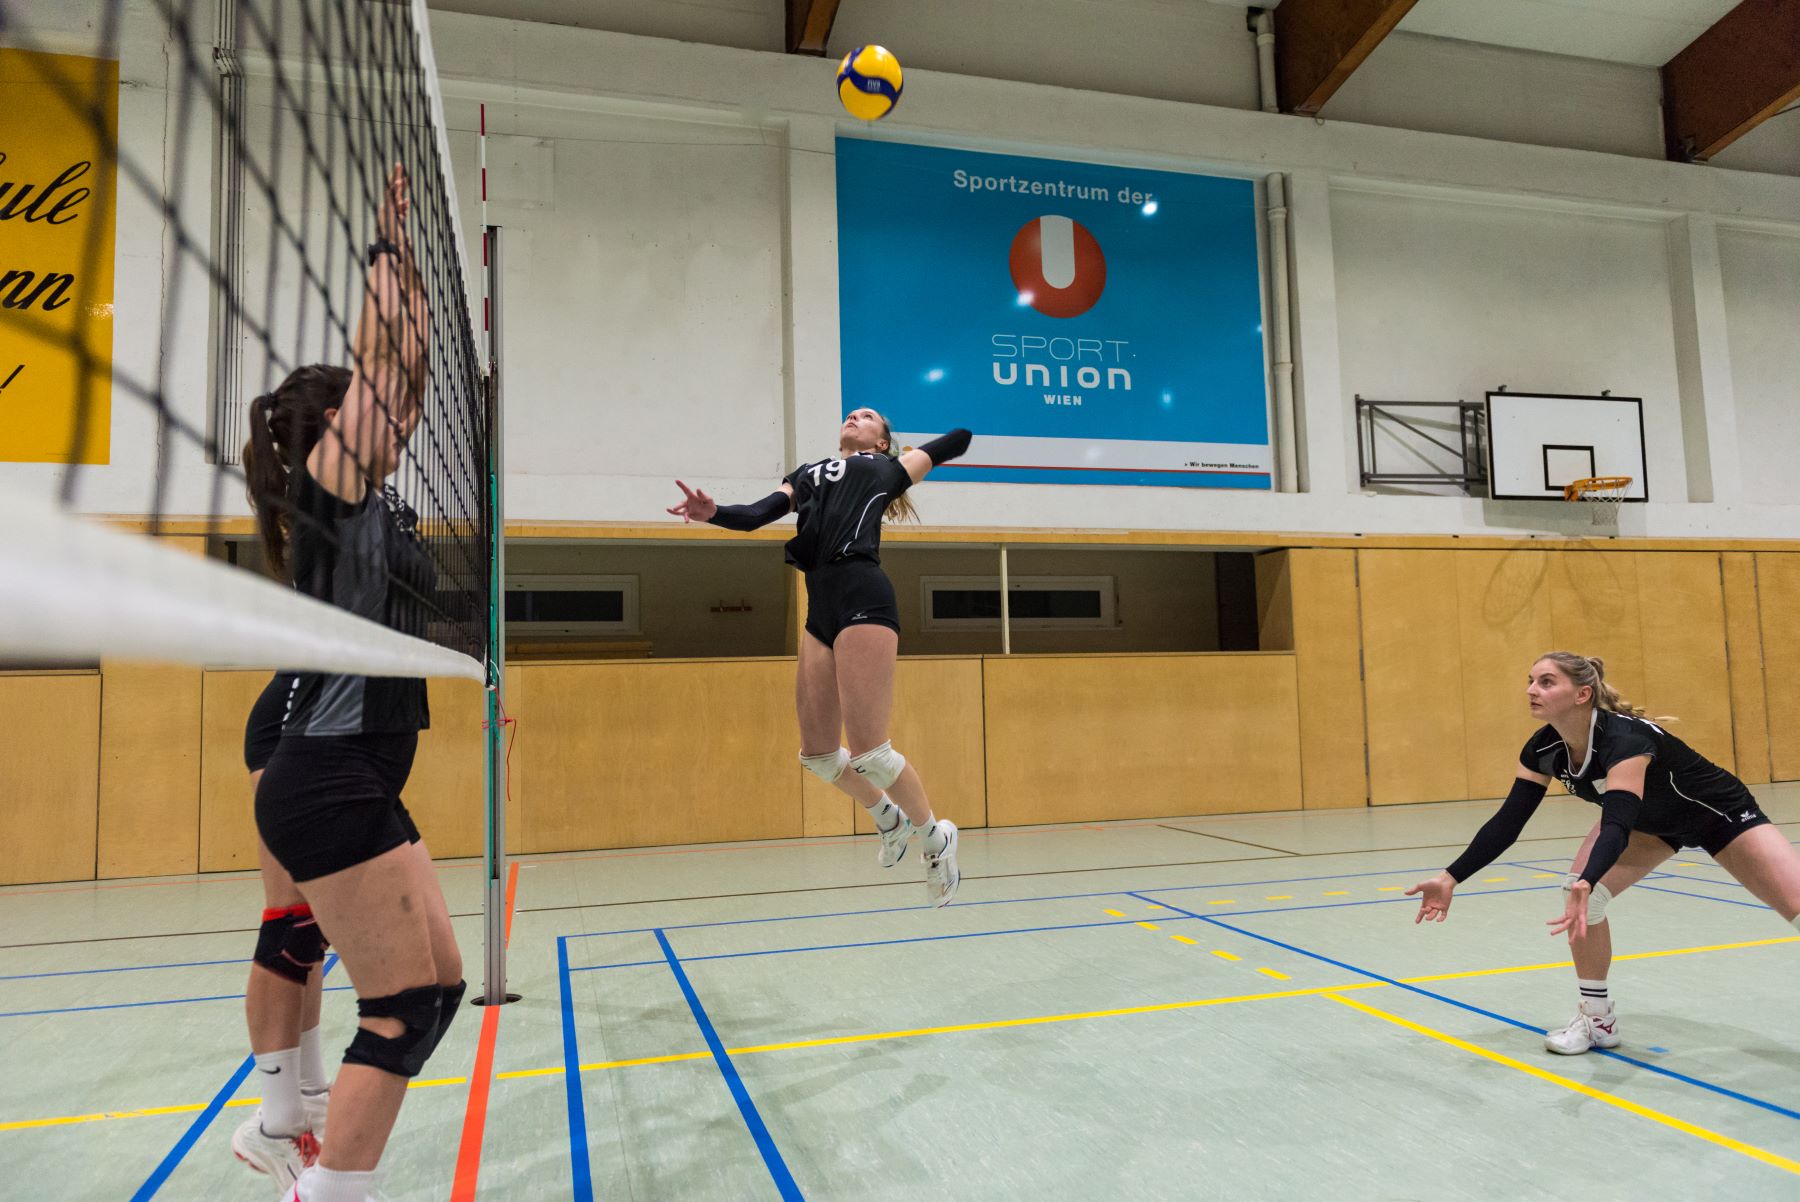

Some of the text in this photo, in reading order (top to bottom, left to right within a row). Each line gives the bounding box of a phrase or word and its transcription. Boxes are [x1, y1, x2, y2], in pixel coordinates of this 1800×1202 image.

[0, 152, 91, 225] ule
[953, 169, 1153, 206] Sportzentrum der
[991, 333, 1130, 363] SPORT
[1043, 394, 1083, 406] WIEN
